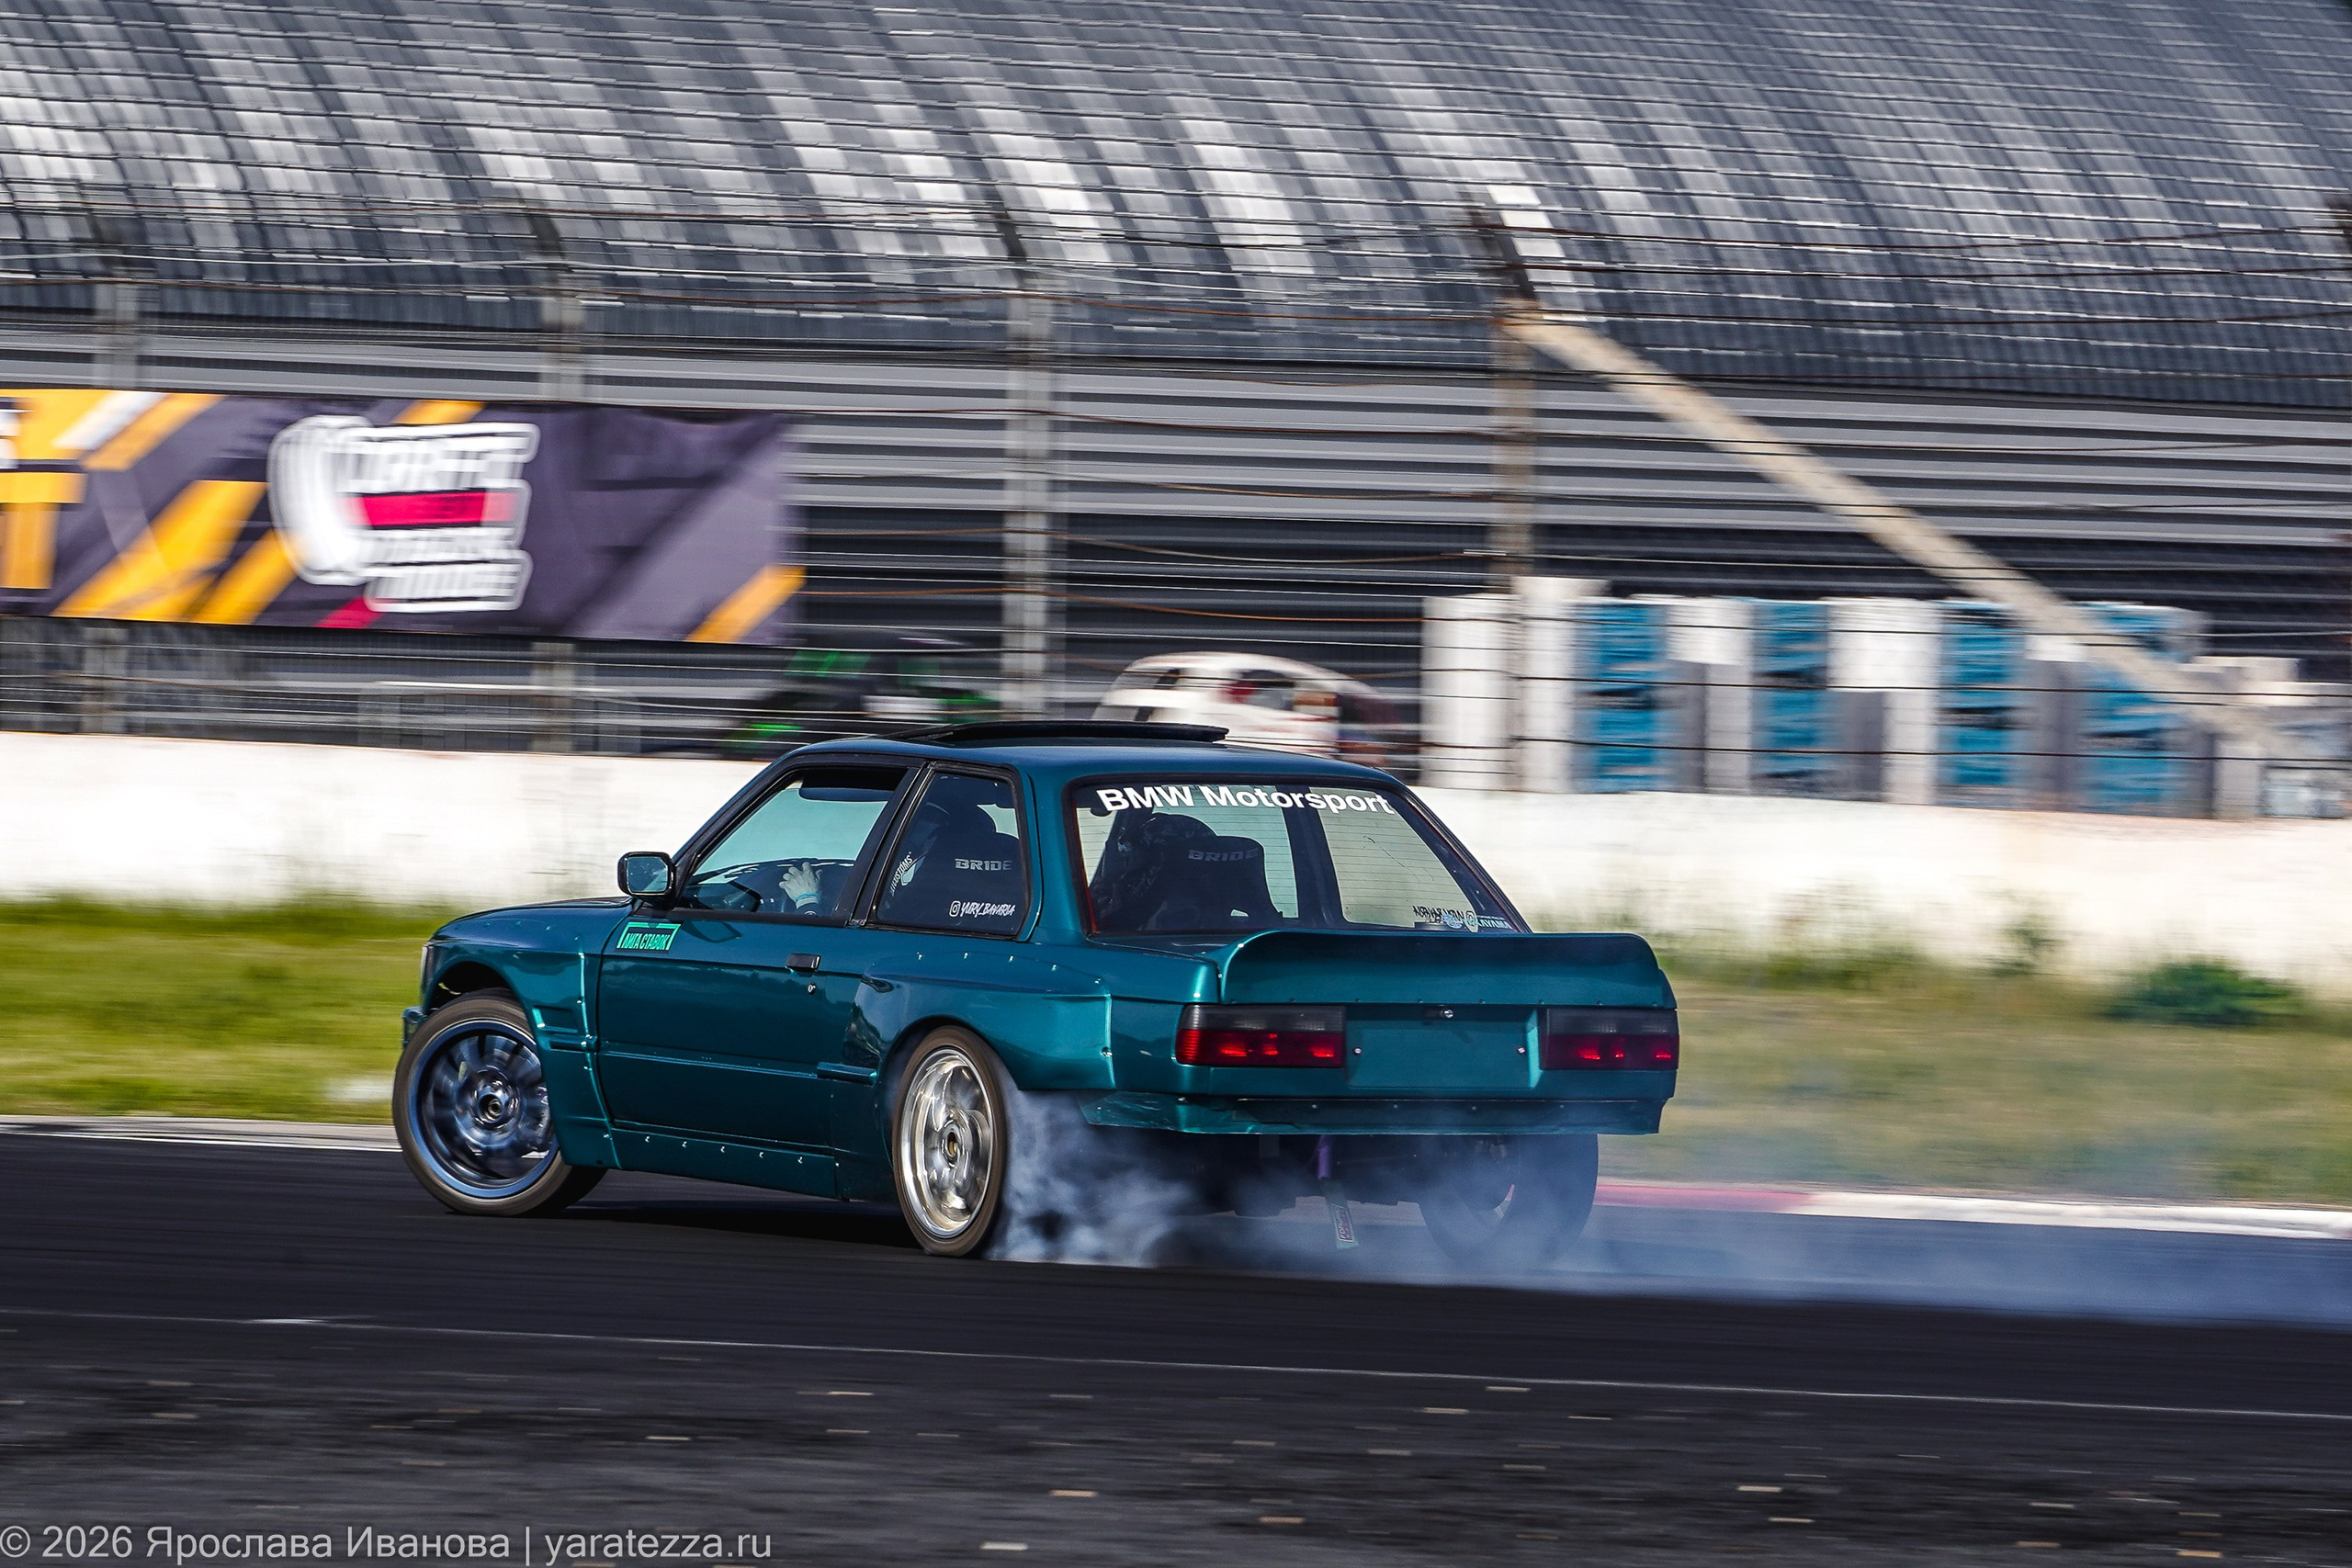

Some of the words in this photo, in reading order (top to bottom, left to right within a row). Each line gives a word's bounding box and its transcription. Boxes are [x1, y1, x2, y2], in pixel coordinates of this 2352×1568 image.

[1096, 785, 1193, 812] BMW
[1198, 785, 1396, 815] Motorsport
[1187, 848, 1259, 863] BRIDE
[955, 858, 1012, 871] BRIDE
[960, 902, 1016, 918] YURY_BAVARIA
[621, 932, 643, 949] ЛИГА
[639, 933, 671, 951] СТАВОК
